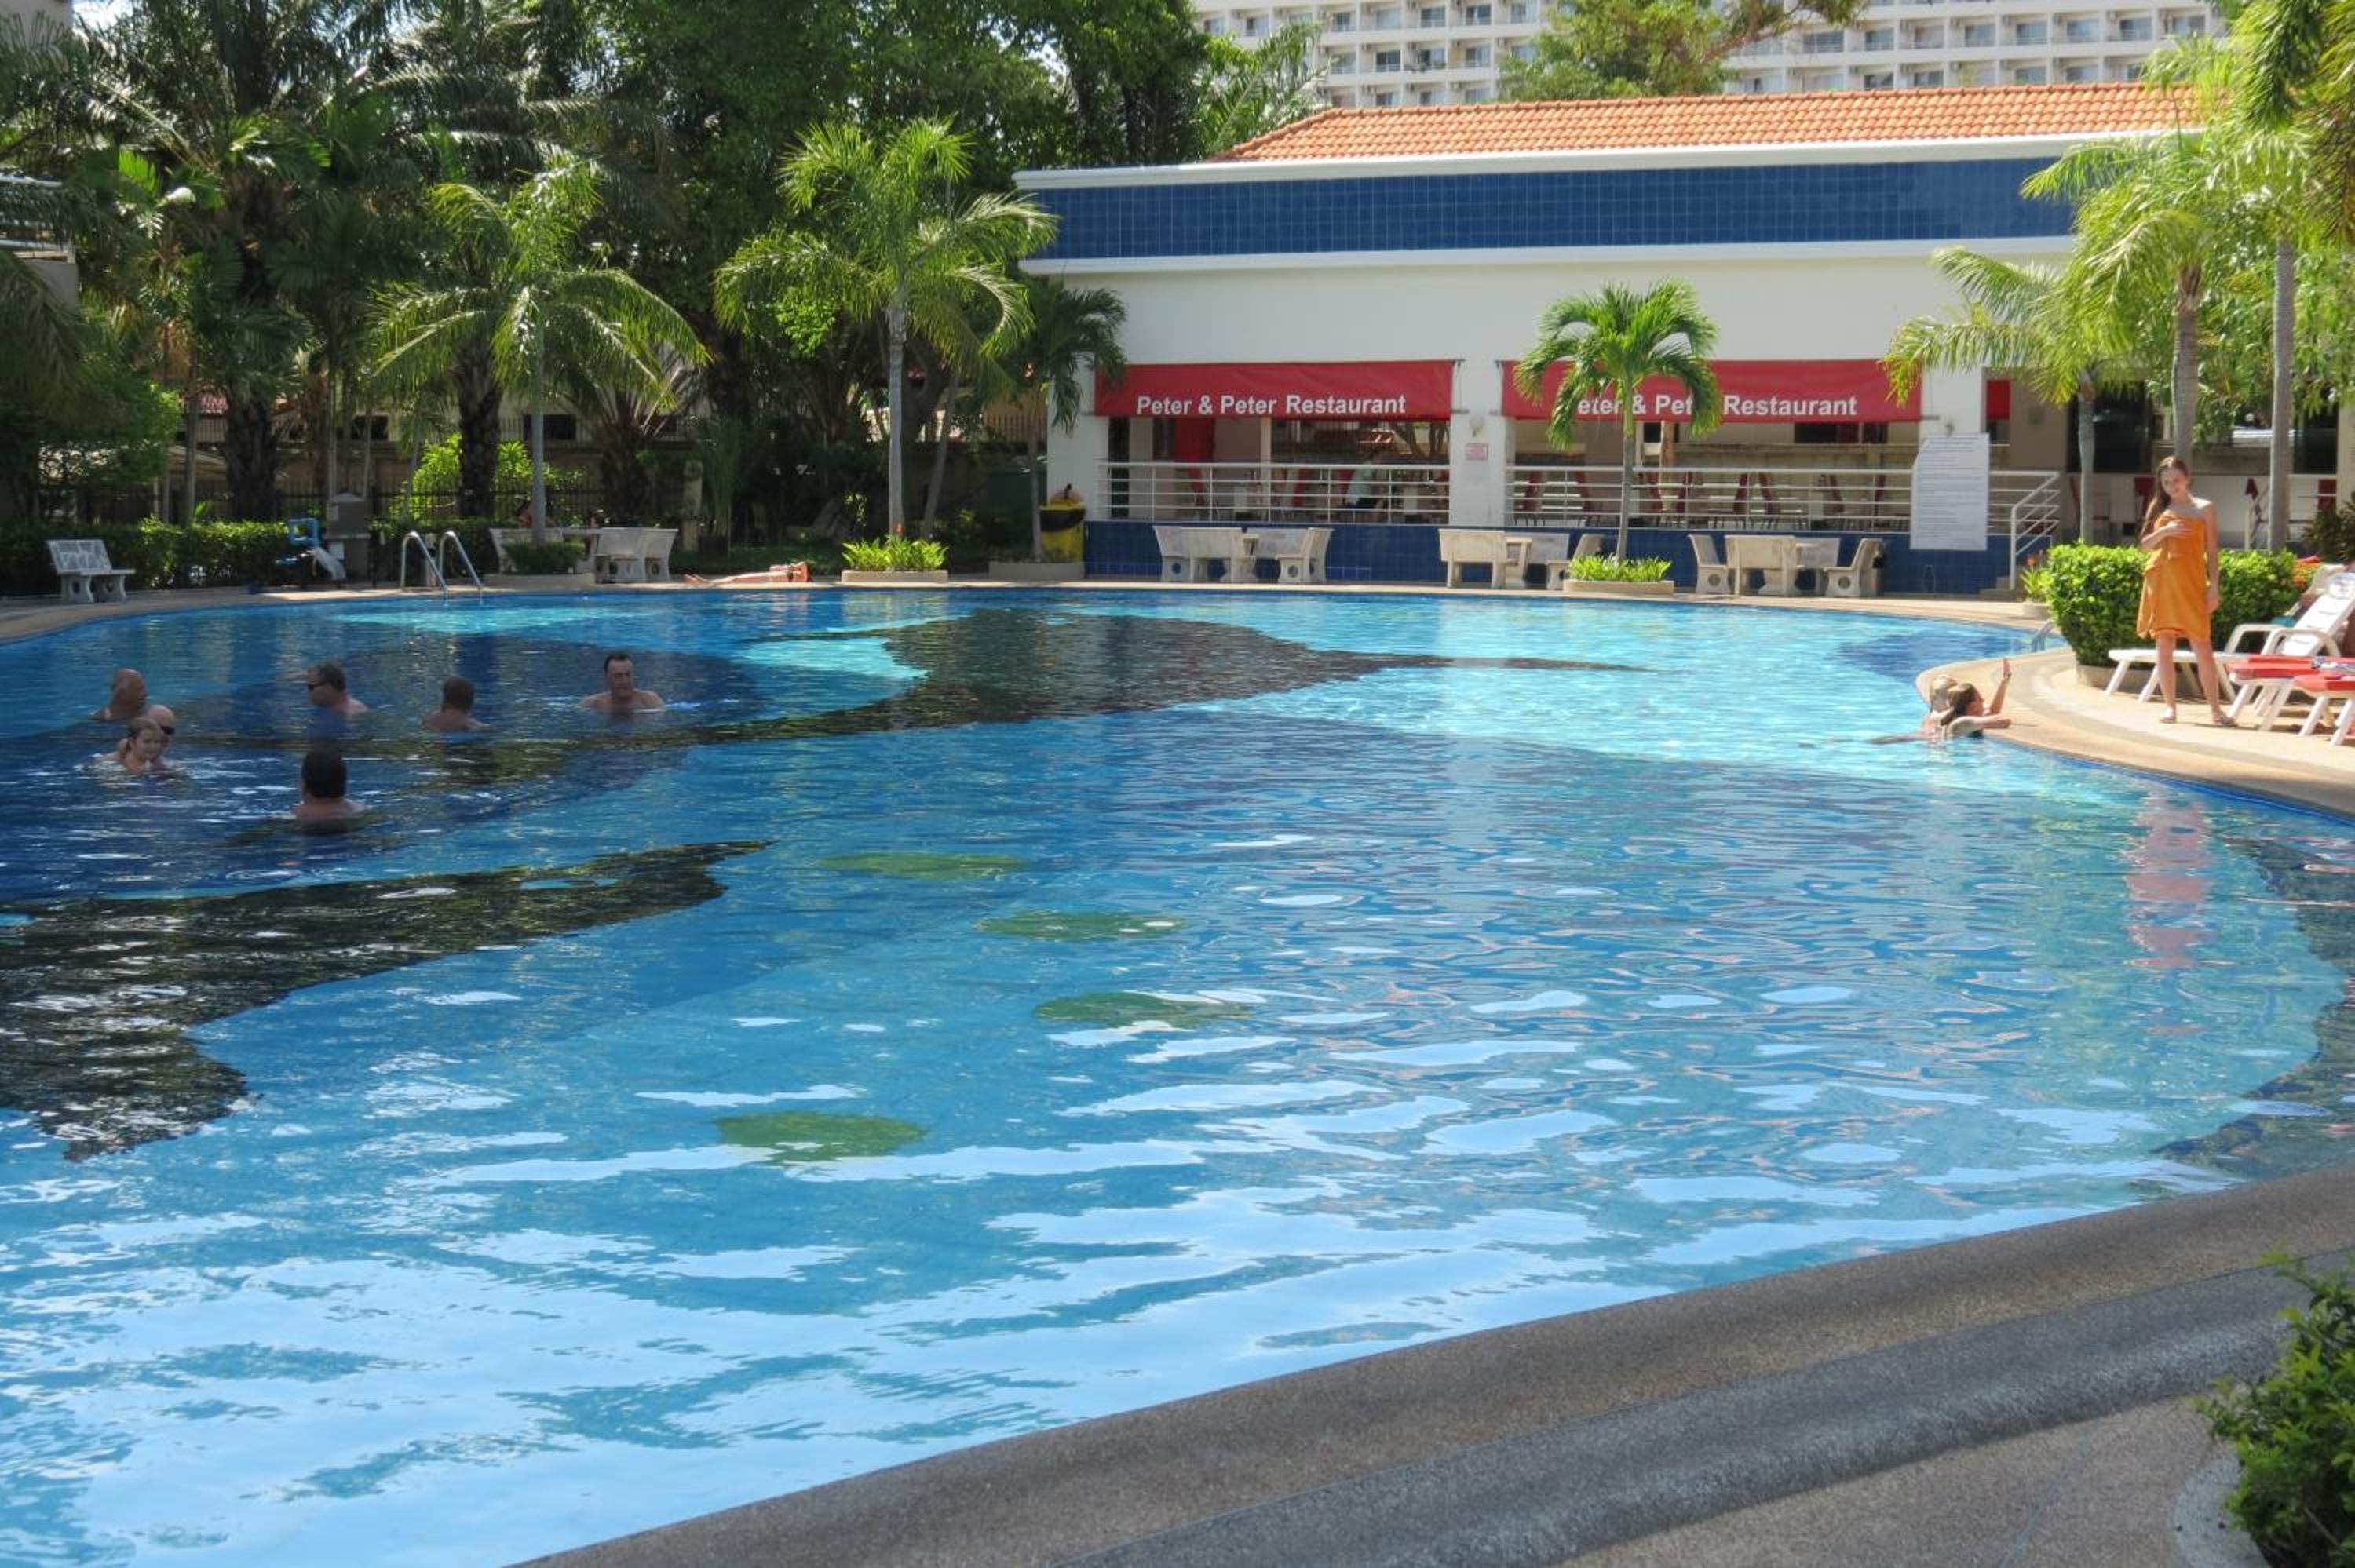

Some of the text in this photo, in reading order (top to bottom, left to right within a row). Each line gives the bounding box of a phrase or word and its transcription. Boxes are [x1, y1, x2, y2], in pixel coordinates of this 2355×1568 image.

[1137, 394, 1407, 414] Peter & Peter Restaurant
[1576, 393, 1857, 416] eter & Pet Restaurant
